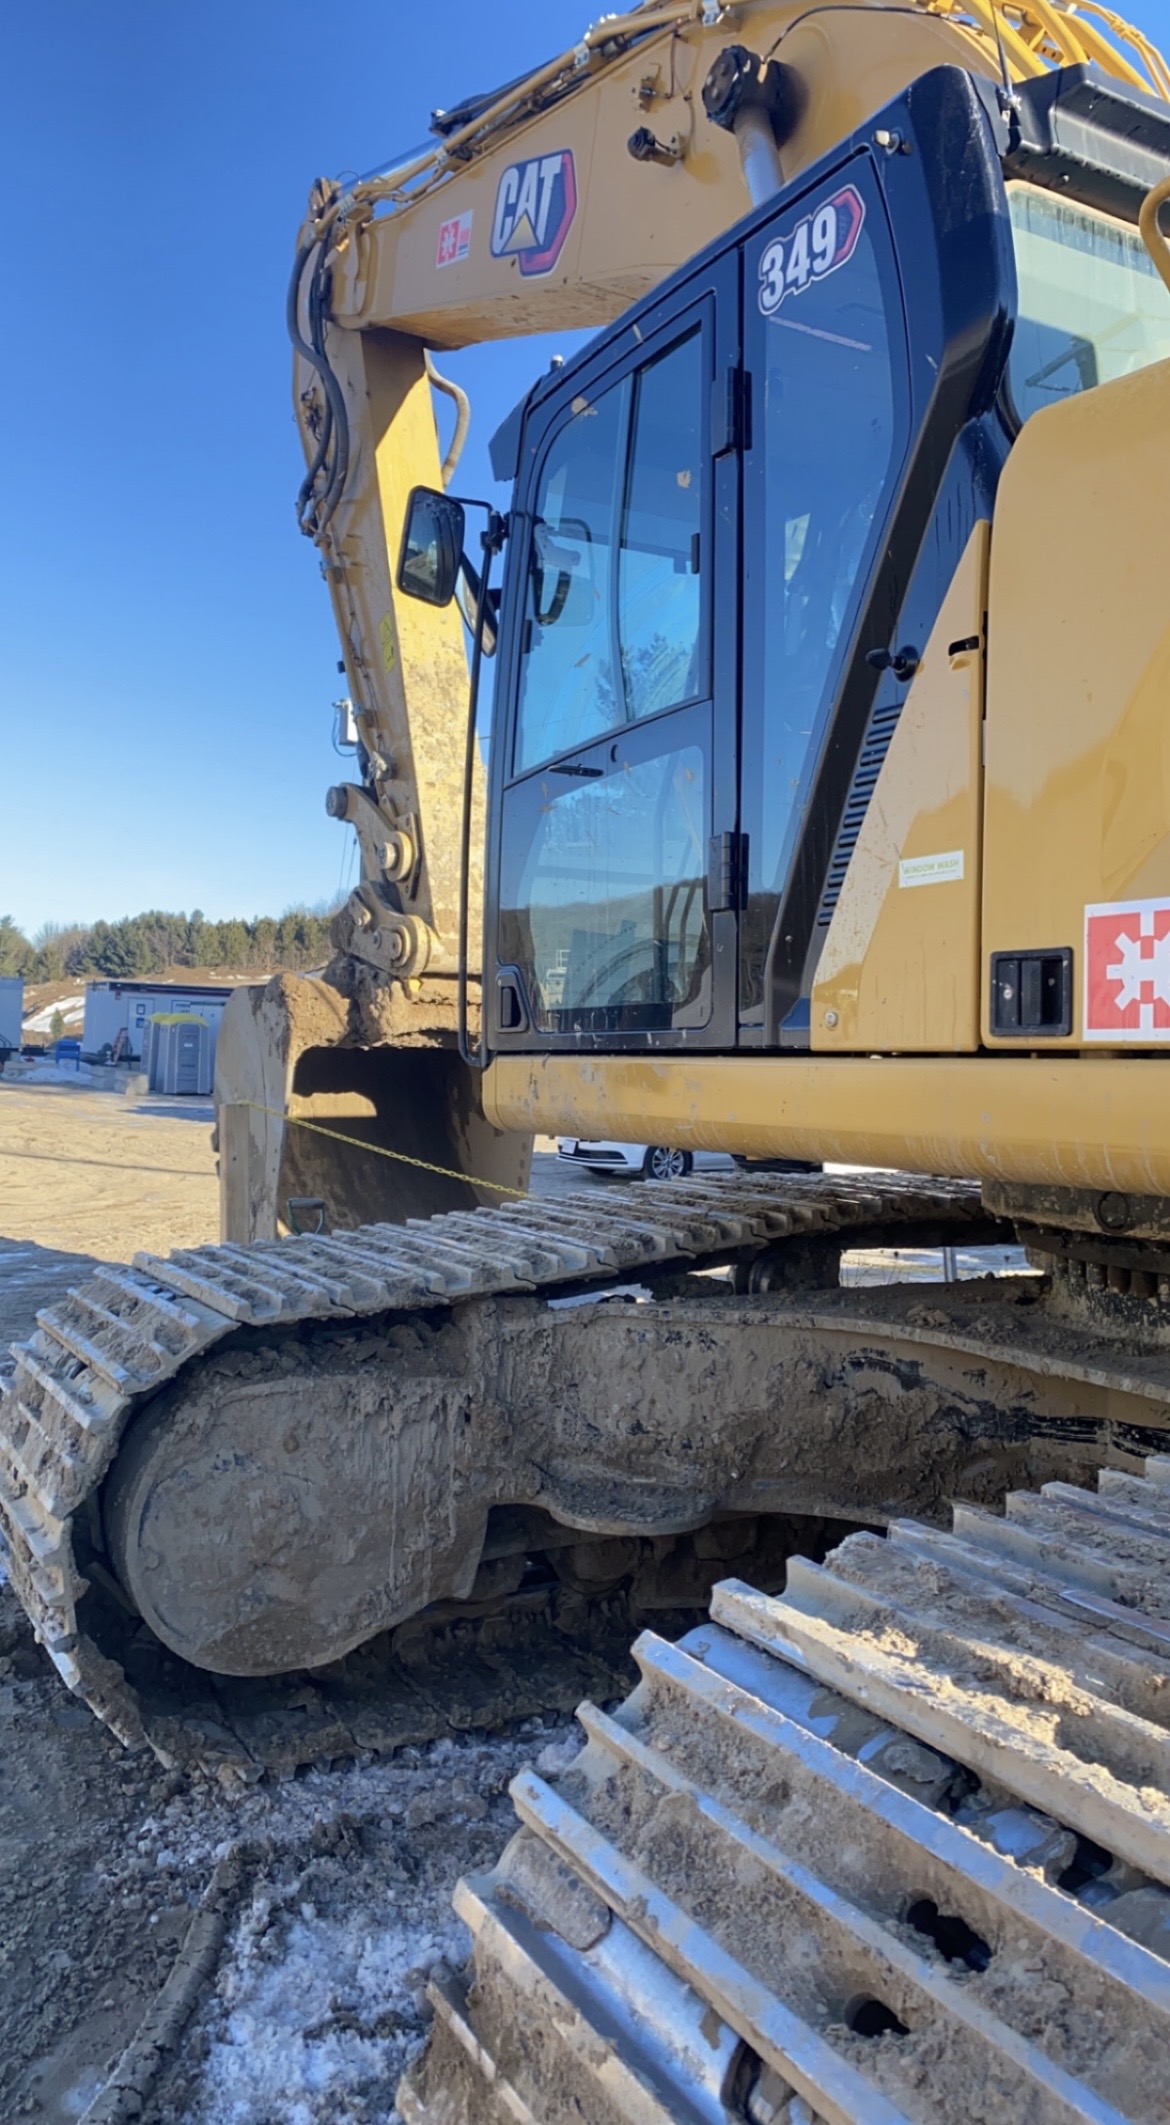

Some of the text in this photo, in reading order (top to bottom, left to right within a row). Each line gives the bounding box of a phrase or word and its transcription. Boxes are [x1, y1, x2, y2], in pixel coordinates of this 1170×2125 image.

[492, 154, 562, 254] CAT
[762, 205, 836, 308] 349
[904, 863, 935, 875] WINDOW
[936, 859, 960, 870] WASH
